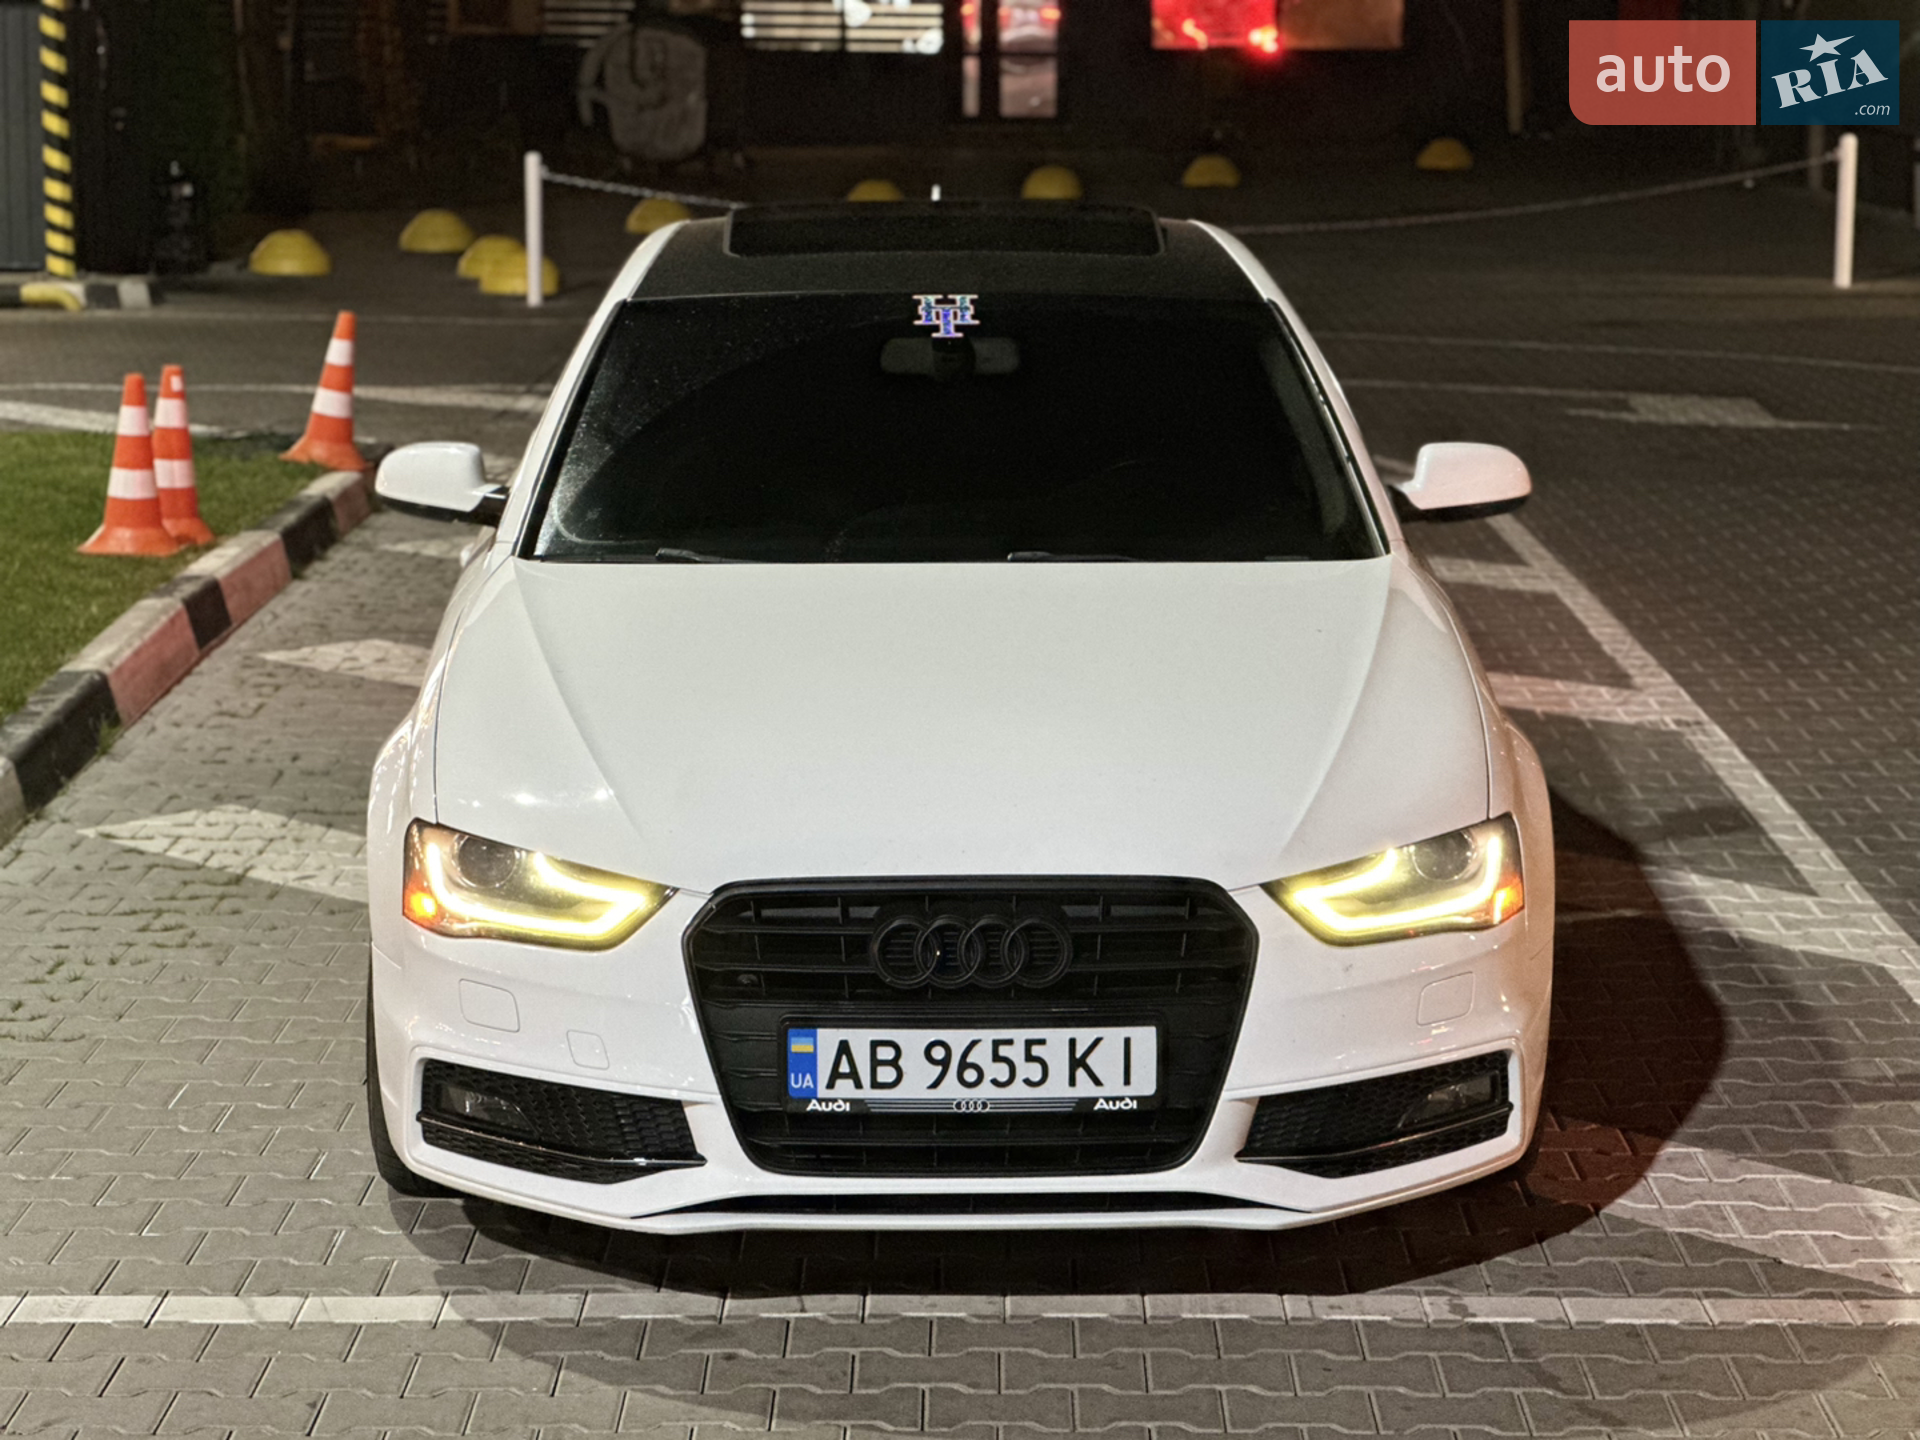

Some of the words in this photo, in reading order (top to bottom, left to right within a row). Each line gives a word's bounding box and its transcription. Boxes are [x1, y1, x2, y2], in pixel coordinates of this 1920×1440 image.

[825, 1039, 904, 1090] AB
[923, 1038, 1049, 1089] 9655
[790, 1073, 814, 1089] UA
[806, 1099, 850, 1112] Audi
[1093, 1097, 1138, 1110] Audi
